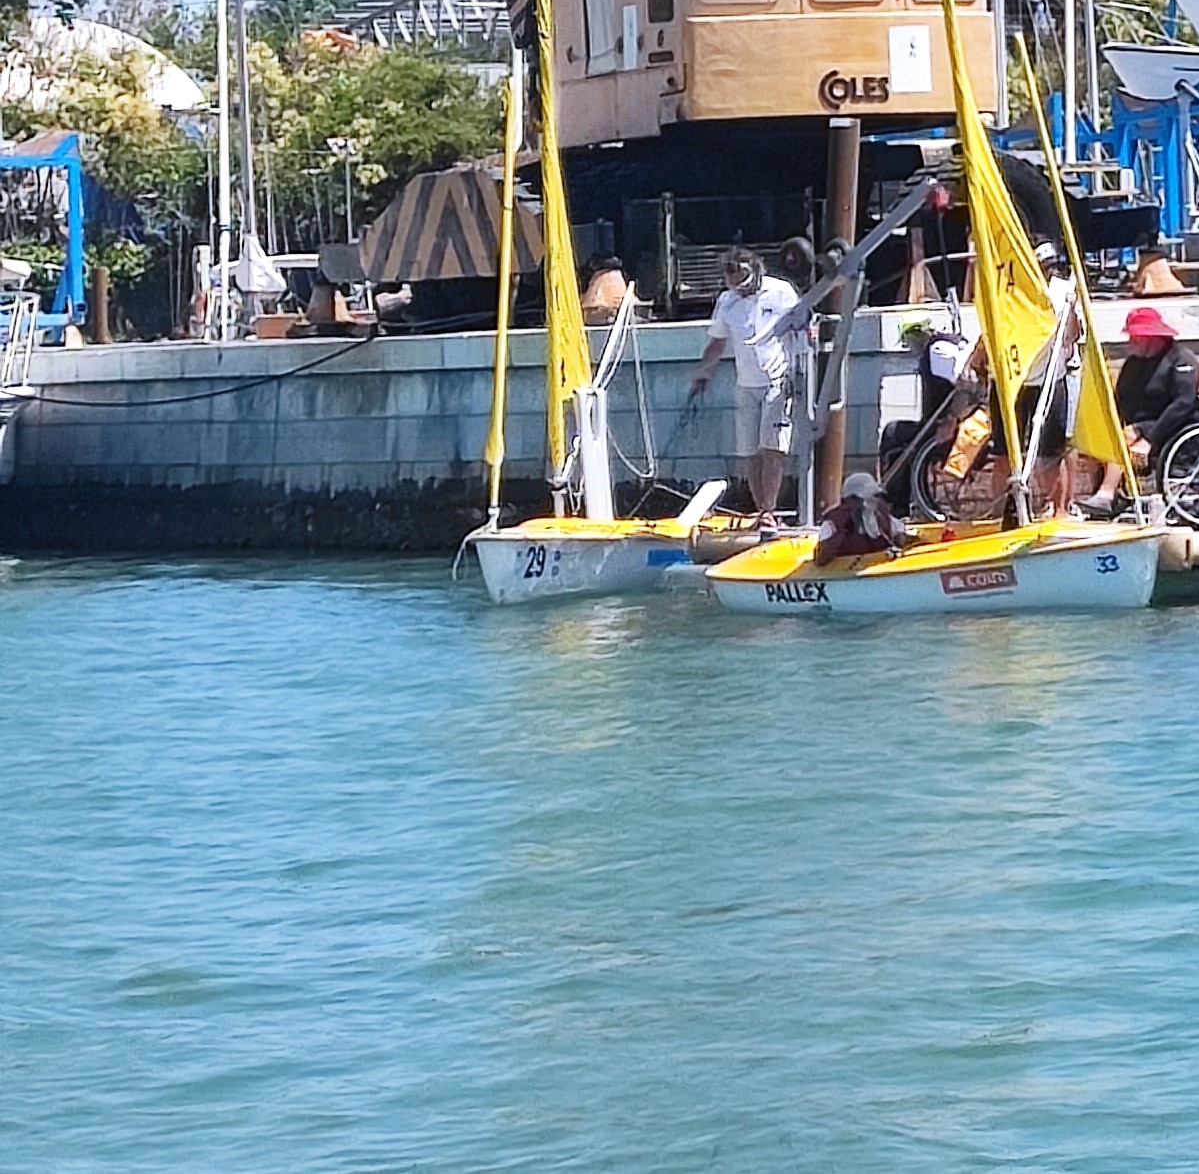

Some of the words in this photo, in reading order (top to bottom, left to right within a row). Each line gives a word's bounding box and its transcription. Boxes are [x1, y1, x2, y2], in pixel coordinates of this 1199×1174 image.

[818, 69, 890, 111] COLES
[523, 544, 547, 579] 29
[1095, 554, 1121, 575] 33
[764, 582, 830, 603] PALLEX
